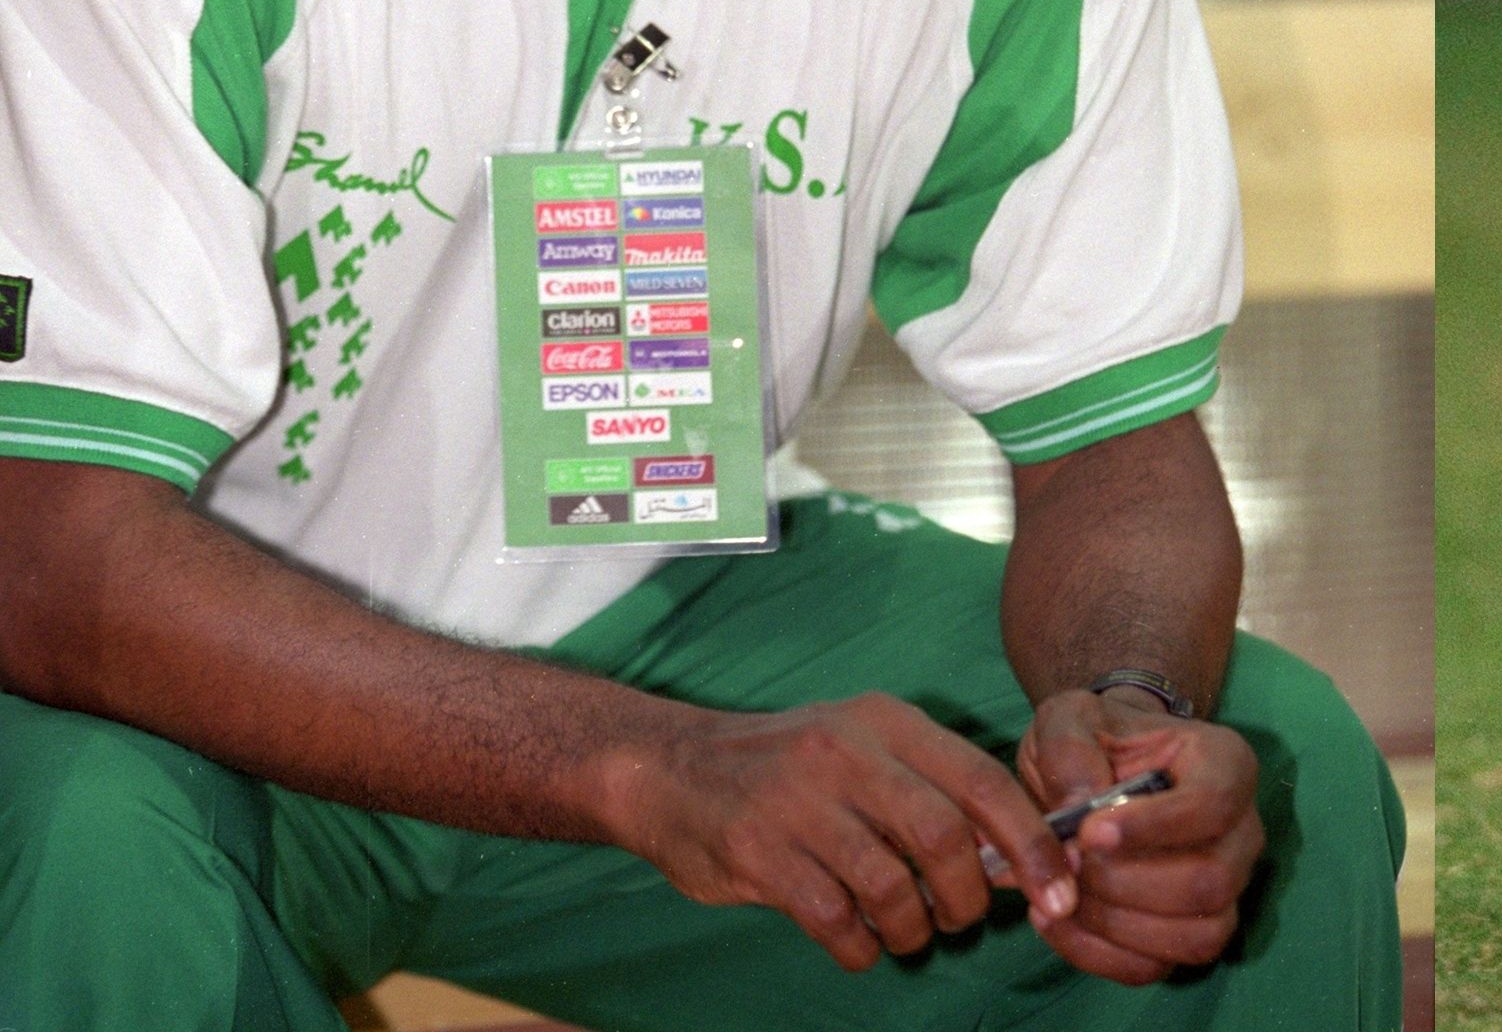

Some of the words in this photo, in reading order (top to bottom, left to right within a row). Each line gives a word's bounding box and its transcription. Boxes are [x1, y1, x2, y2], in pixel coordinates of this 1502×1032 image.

[539, 206, 617, 228] AMSTEL
[652, 205, 702, 221] Konica
[542, 242, 616, 262] Amway
[544, 279, 617, 296] Canon
[549, 382, 619, 403] EPSON
[592, 416, 666, 436] SANYO
